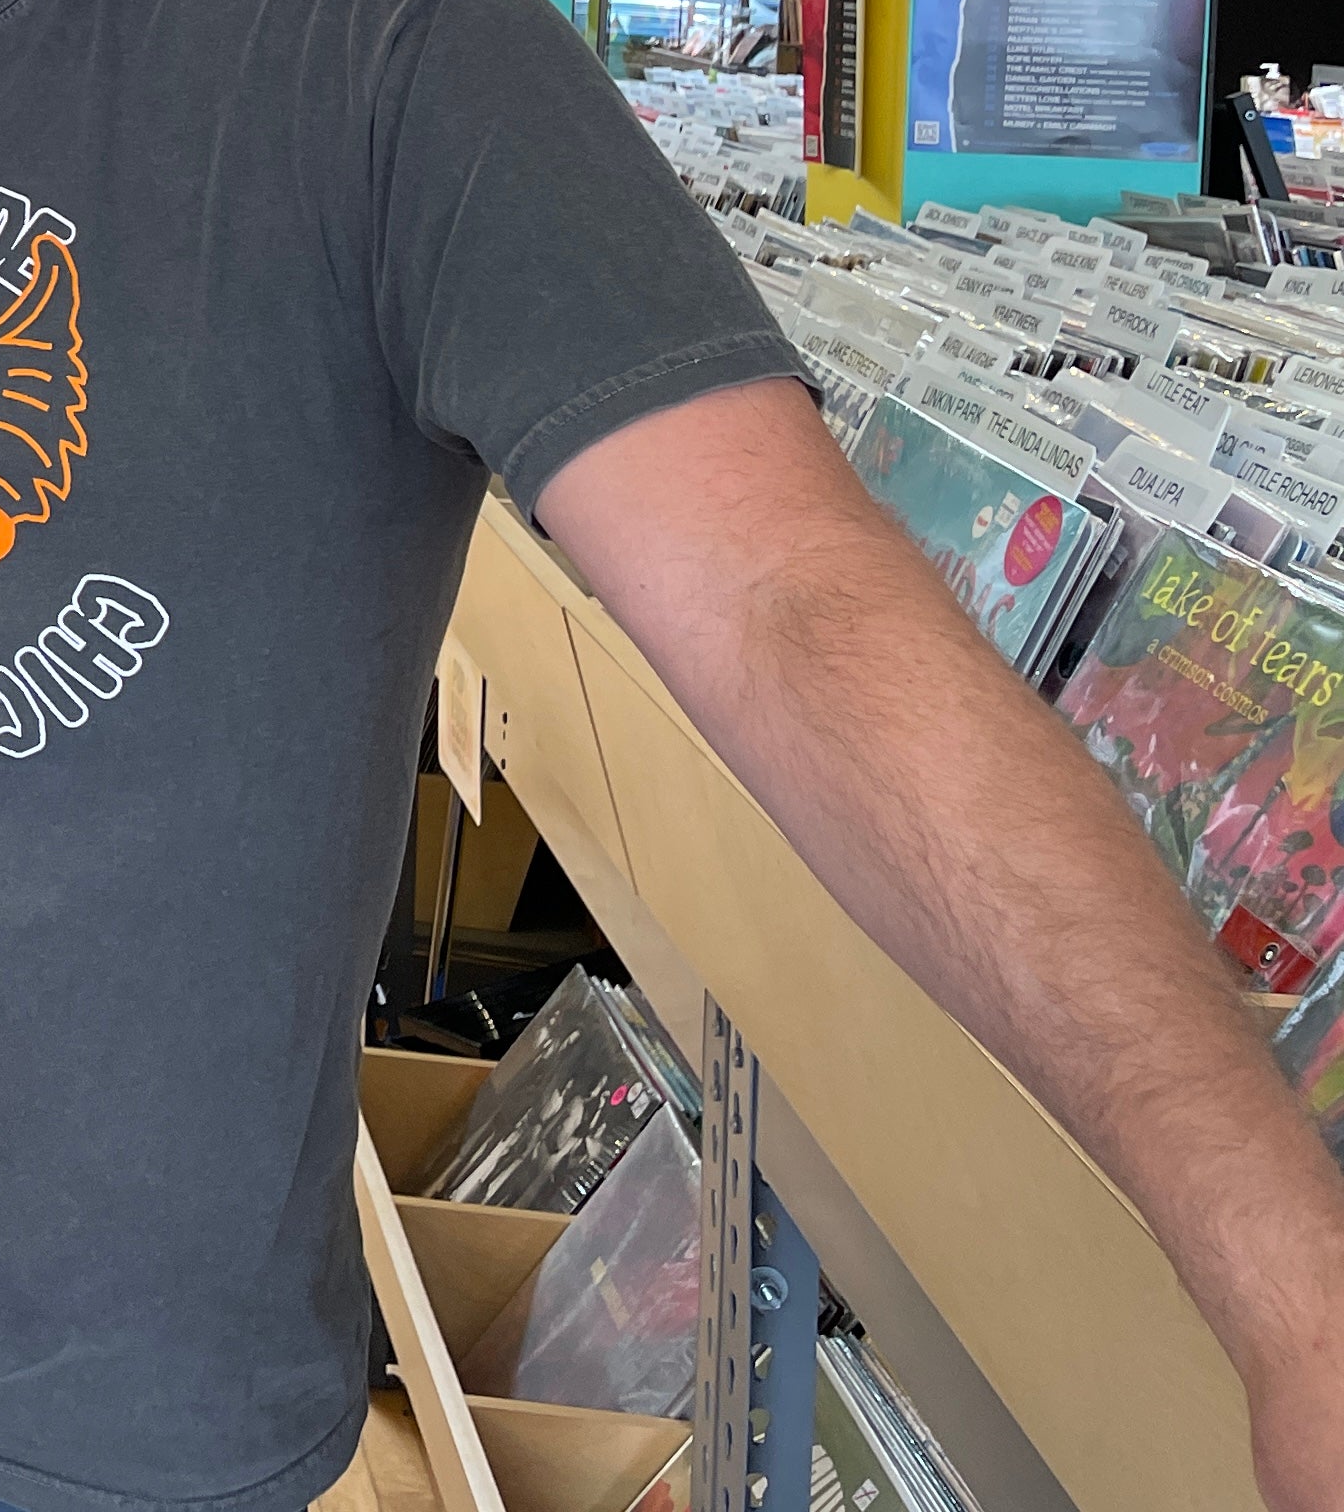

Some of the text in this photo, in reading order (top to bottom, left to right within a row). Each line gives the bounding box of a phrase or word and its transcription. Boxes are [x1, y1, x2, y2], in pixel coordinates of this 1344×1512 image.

[992, 303, 1043, 335] KRAFTWERK
[827, 337, 849, 364] LAKE
[845, 348, 878, 383] STREET
[920, 385, 956, 416] LINKIN
[955, 398, 986, 425] PARK
[1146, 371, 1210, 417] LITTLE FEAT
[986, 410, 1085, 479] THE LINDA LINDAS
[1128, 466, 1186, 508] DUA LIPA
[1237, 457, 1339, 517] LITTLE RICHARD
[1141, 555, 1344, 707] lake of tears
[1145, 638, 1270, 726] a crimson cosmos
